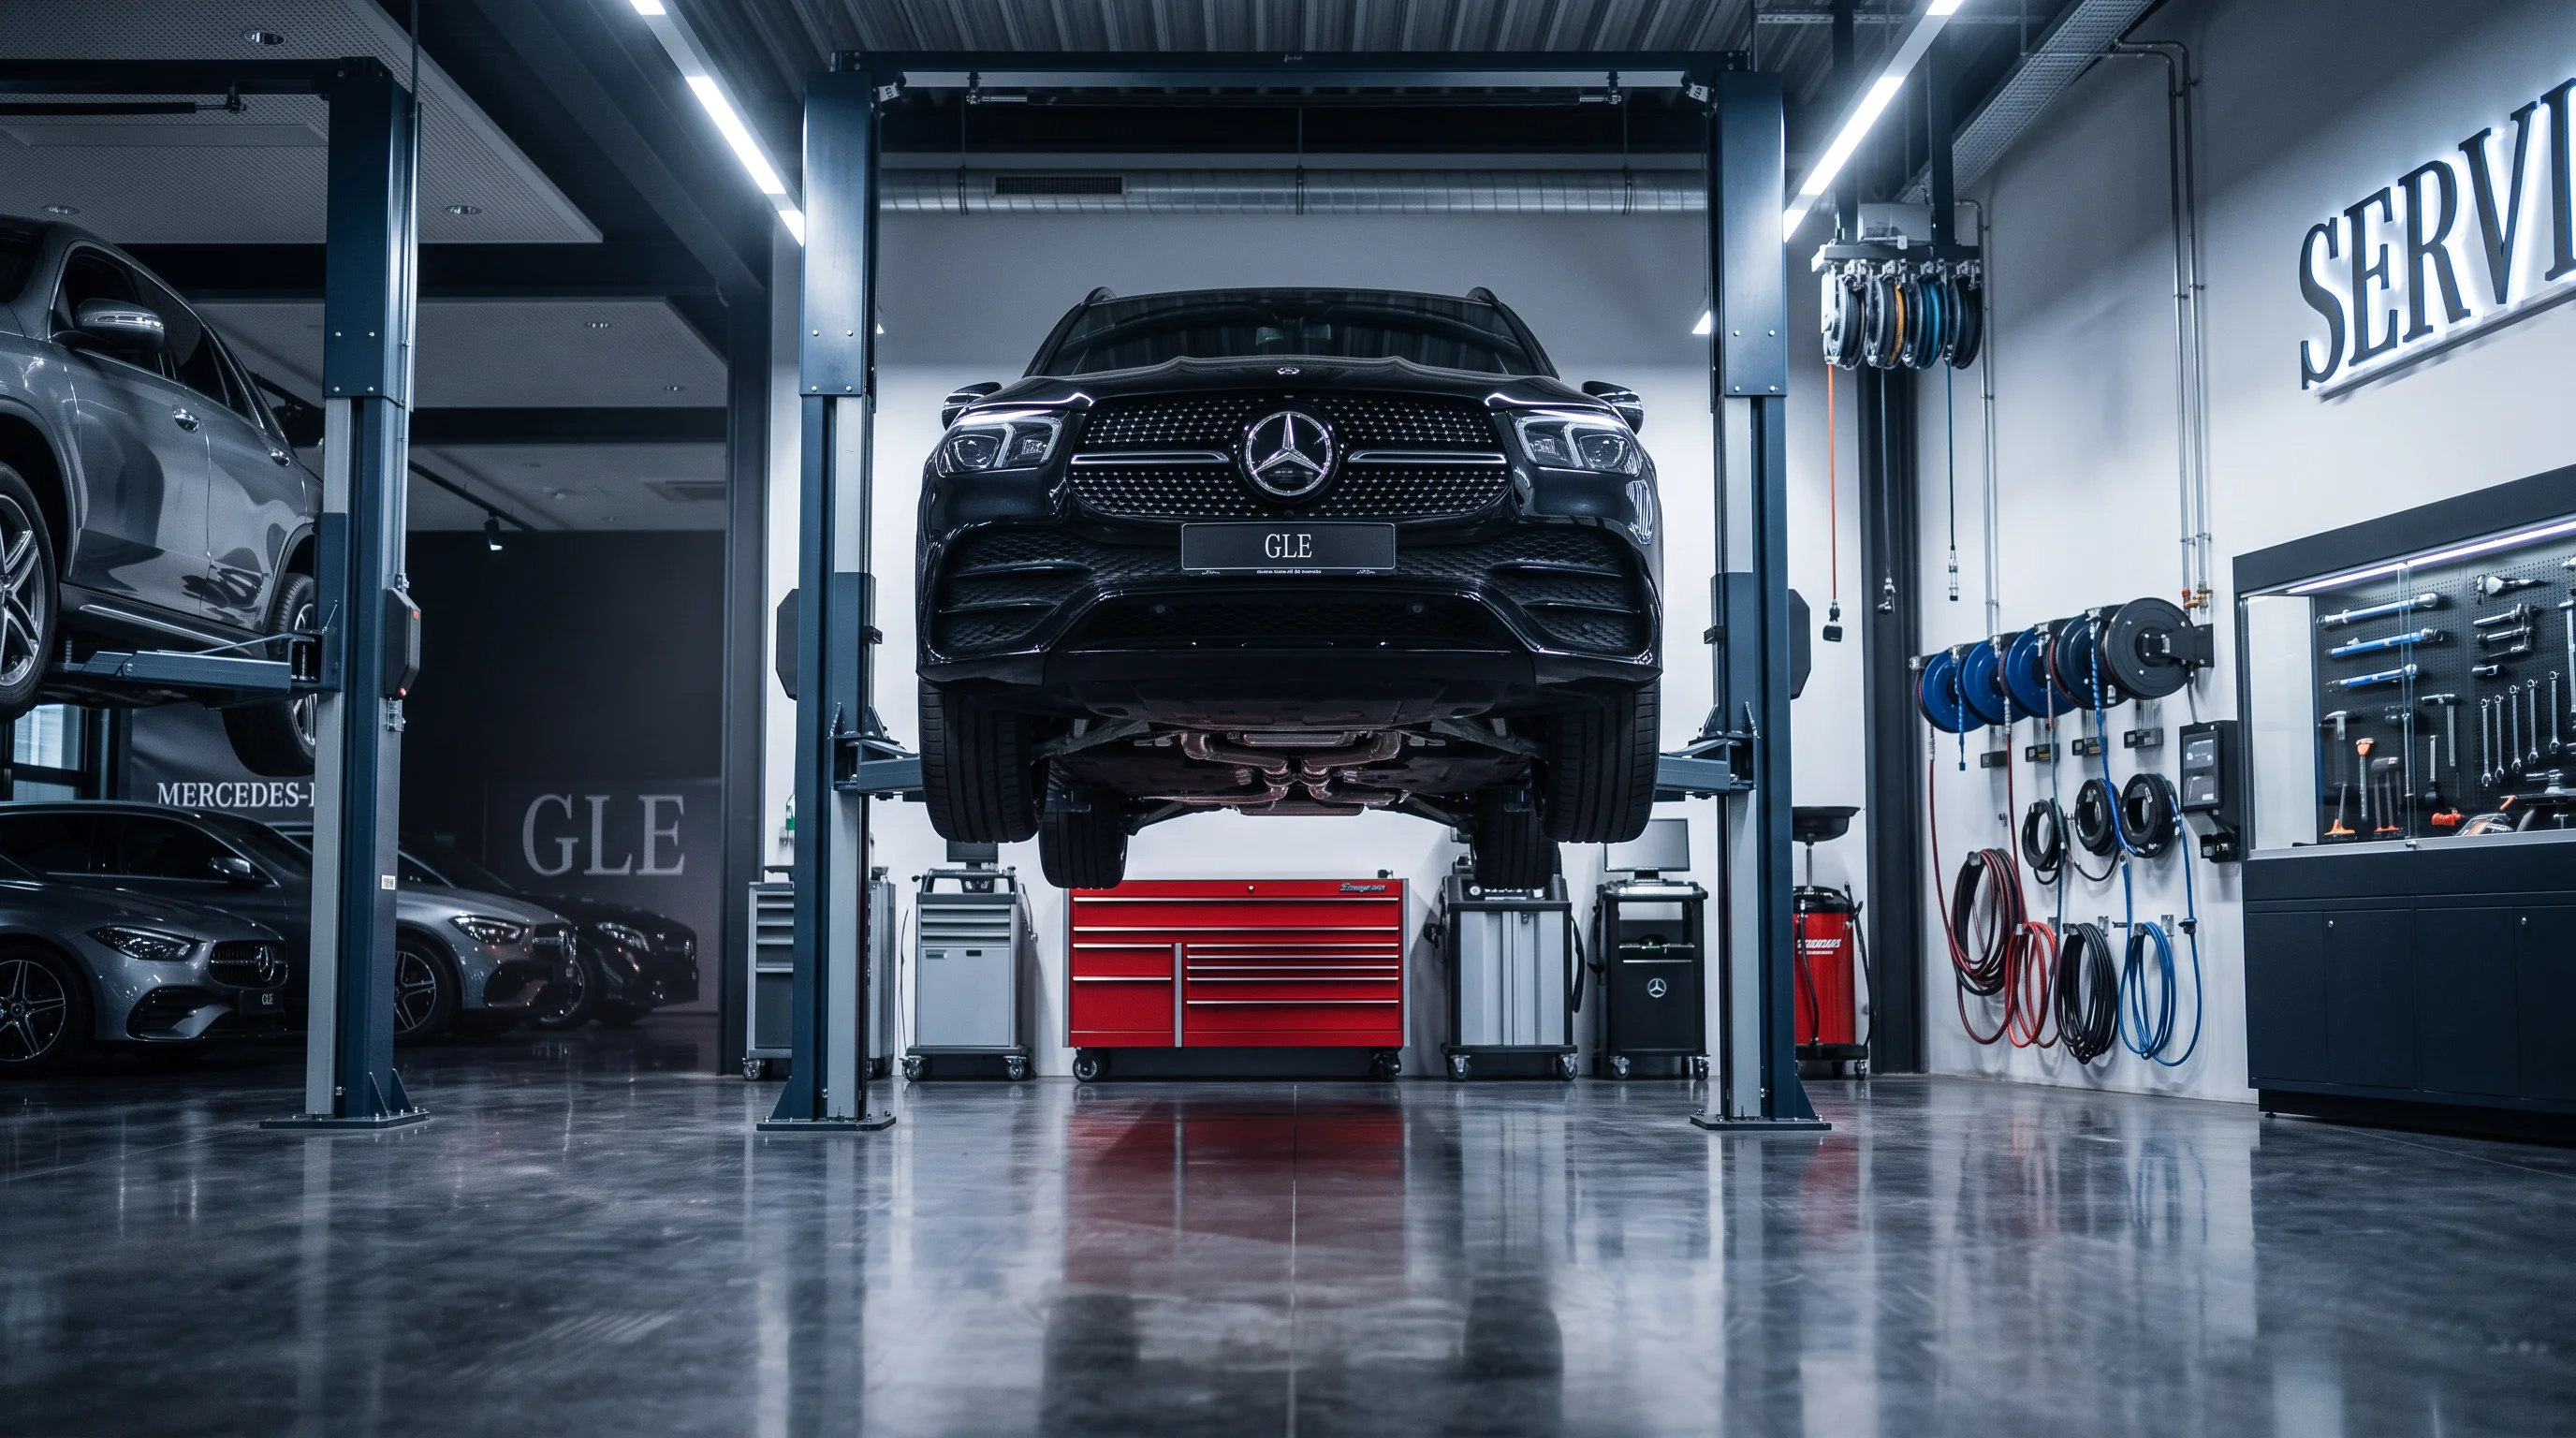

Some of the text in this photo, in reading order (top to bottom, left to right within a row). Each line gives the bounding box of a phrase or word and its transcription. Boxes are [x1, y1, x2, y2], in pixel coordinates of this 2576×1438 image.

[1265, 533, 1312, 559] GLE
[157, 782, 315, 807] MERCEDES-
[522, 794, 685, 876] GLE
